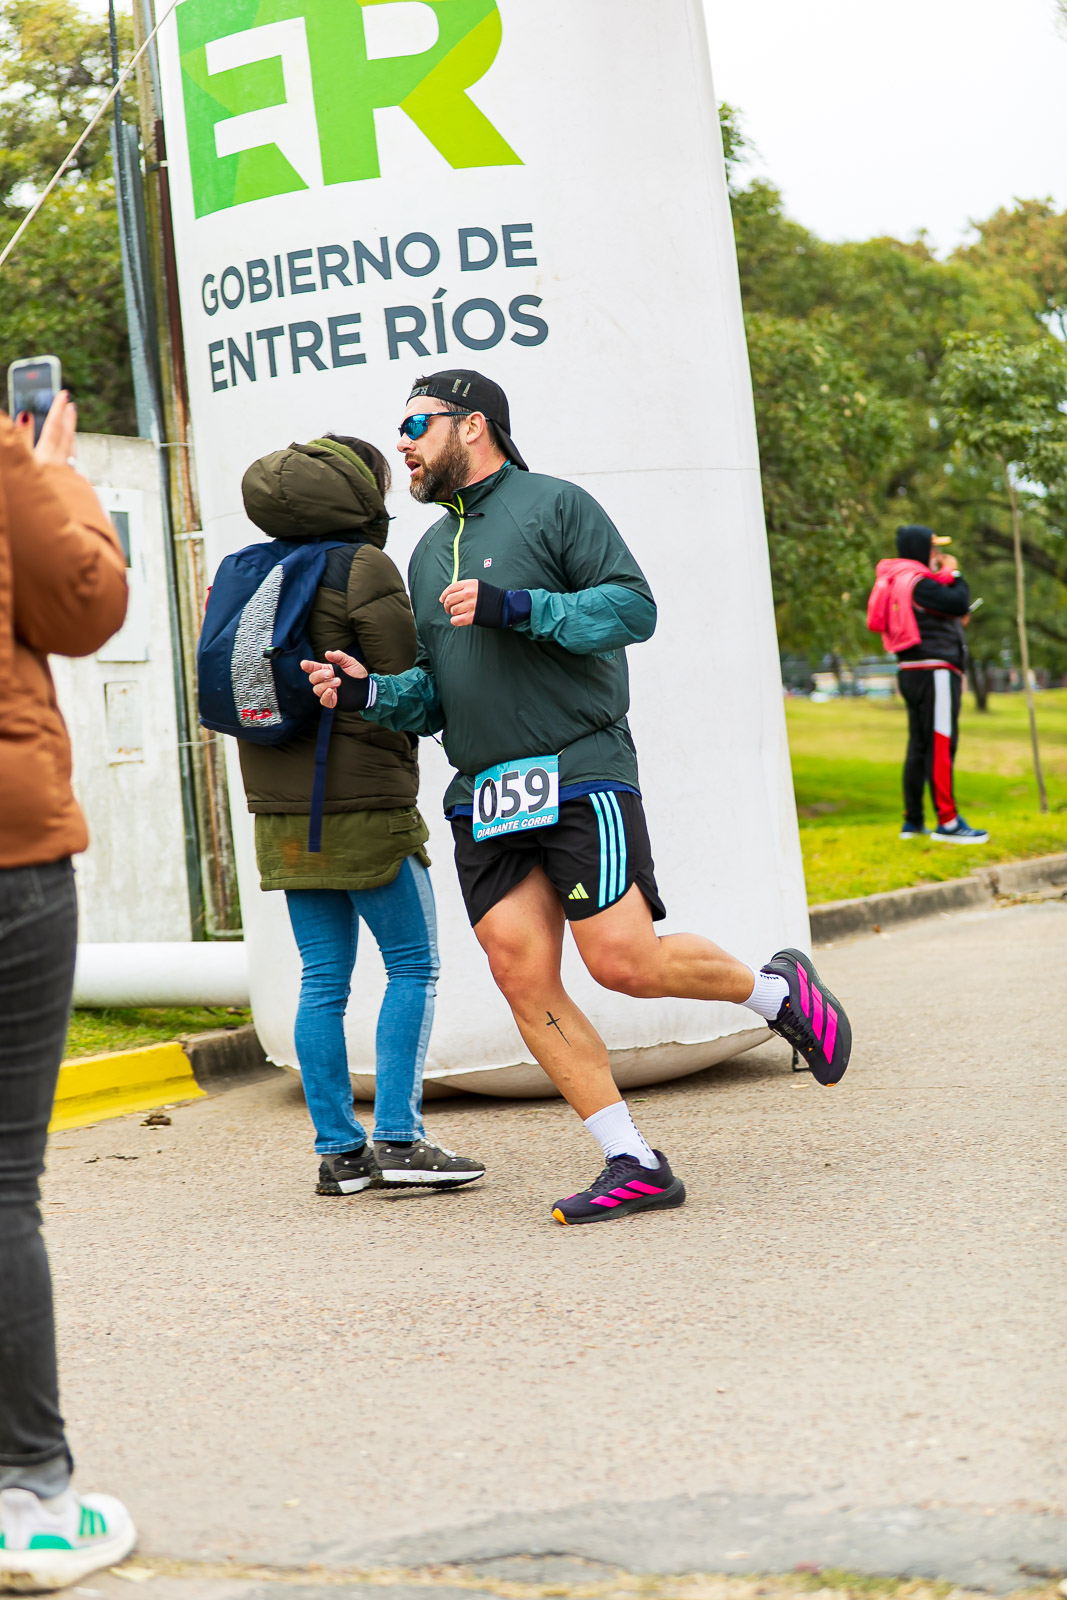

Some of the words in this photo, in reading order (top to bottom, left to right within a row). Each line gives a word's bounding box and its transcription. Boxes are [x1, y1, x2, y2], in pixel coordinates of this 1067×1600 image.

[175, 0, 526, 220] ER
[202, 232, 440, 316] GOBIERNO
[458, 223, 538, 272] DE
[208, 313, 367, 393] ENTRE
[384, 287, 549, 361] RÍOS
[477, 820, 520, 838] DIAMANTE
[521, 815, 554, 827] CORRE
[479, 768, 550, 824] 059
